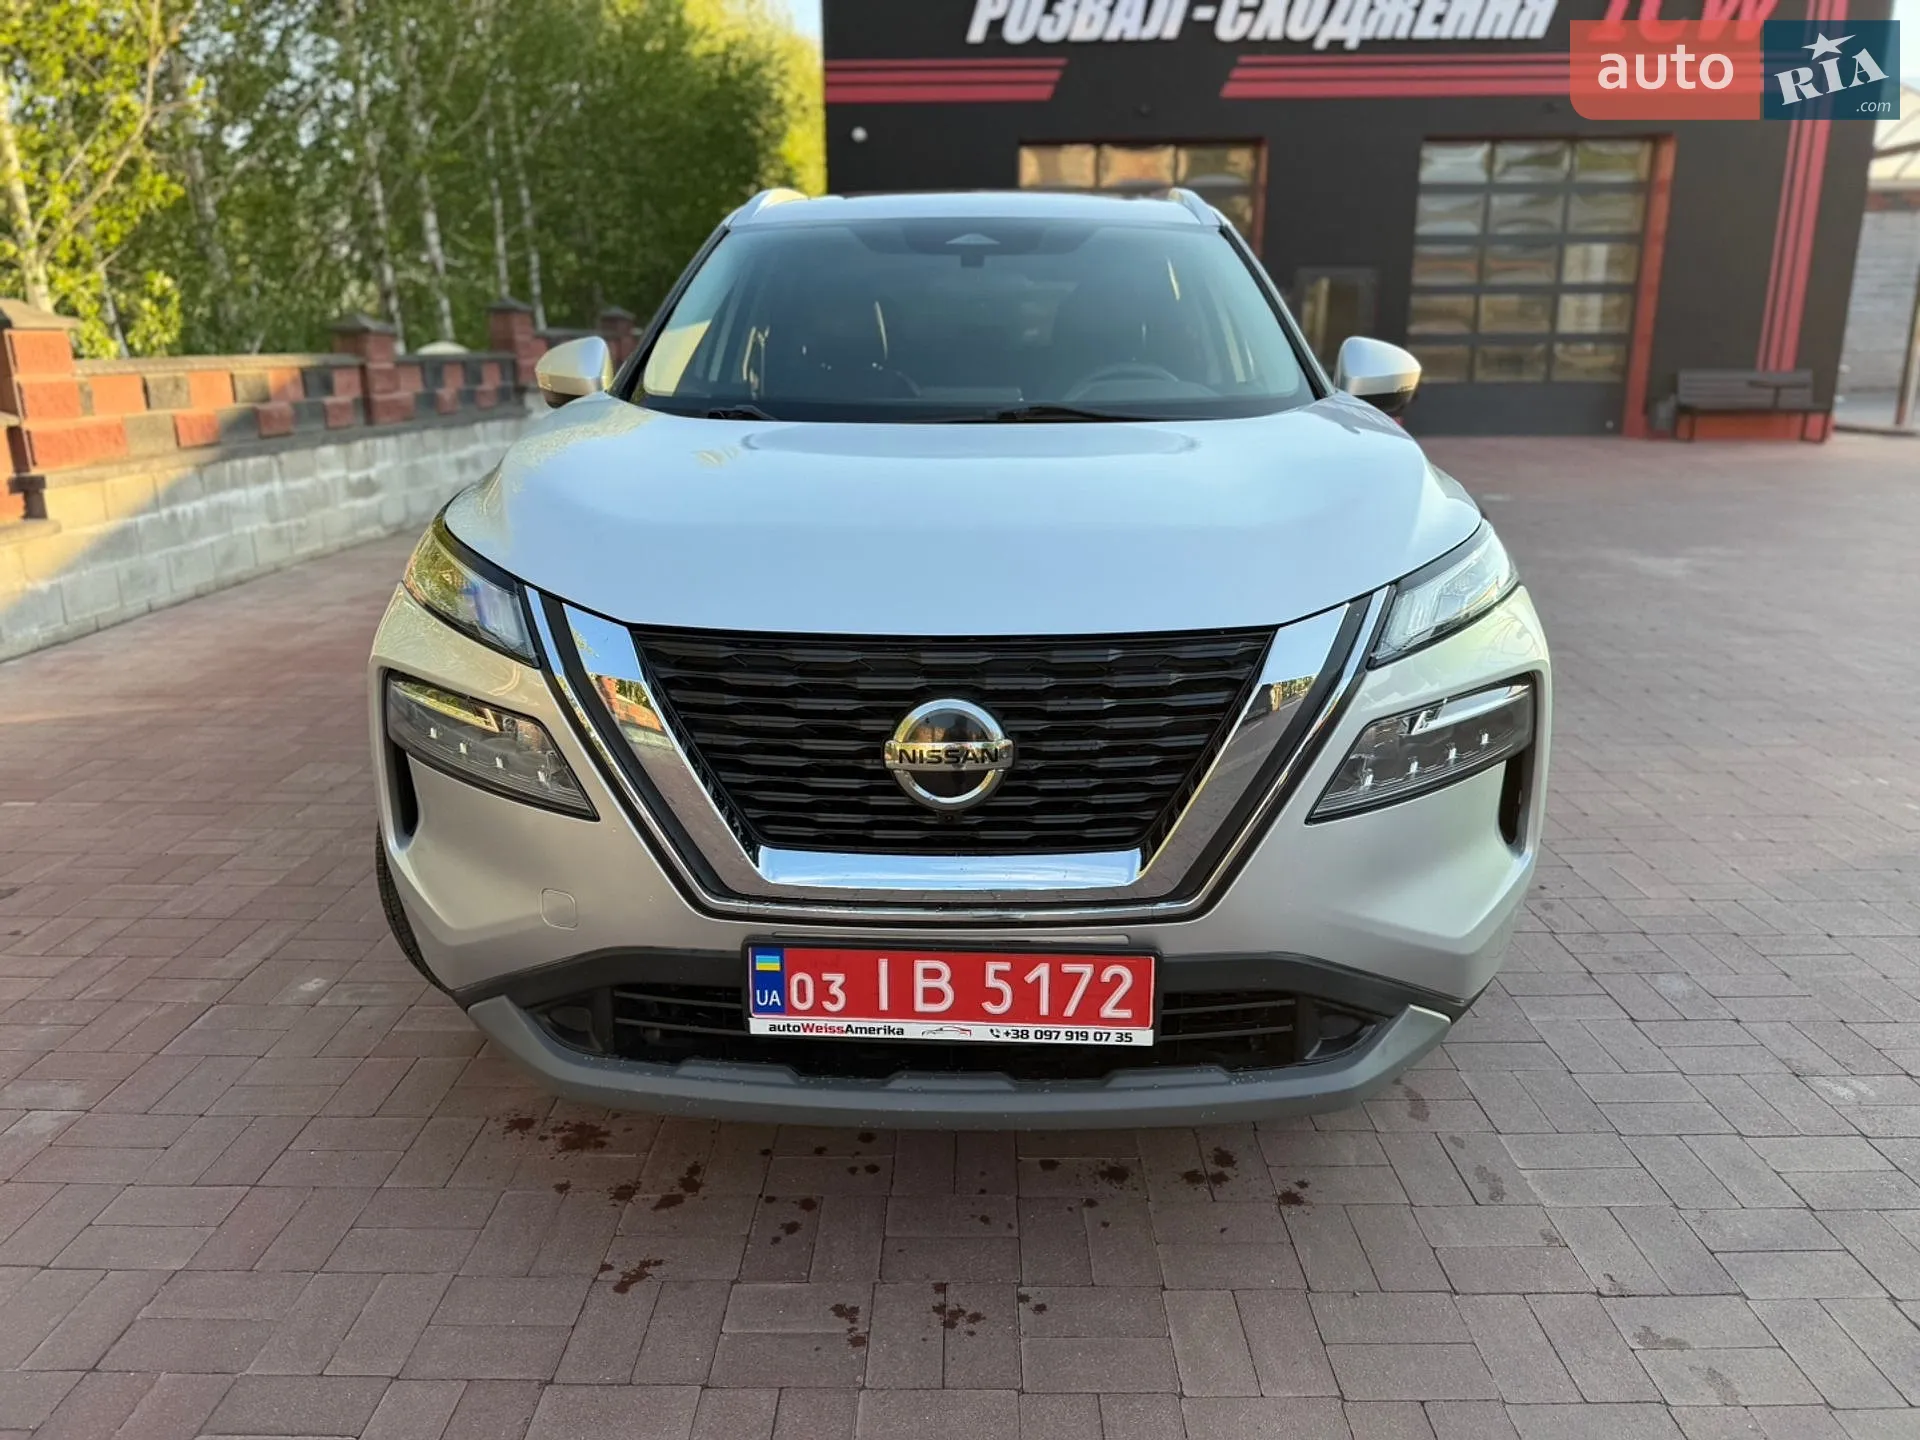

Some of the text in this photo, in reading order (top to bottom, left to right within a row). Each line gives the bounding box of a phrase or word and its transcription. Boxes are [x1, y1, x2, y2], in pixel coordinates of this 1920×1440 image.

[898, 748, 999, 765] NISSAN
[756, 989, 782, 1007] UA
[789, 971, 847, 1013] 03
[981, 960, 1135, 1019] 5172
[768, 1022, 905, 1036] autoWeissAmerika
[1003, 1028, 1133, 1043] +38 097 919 07 35
